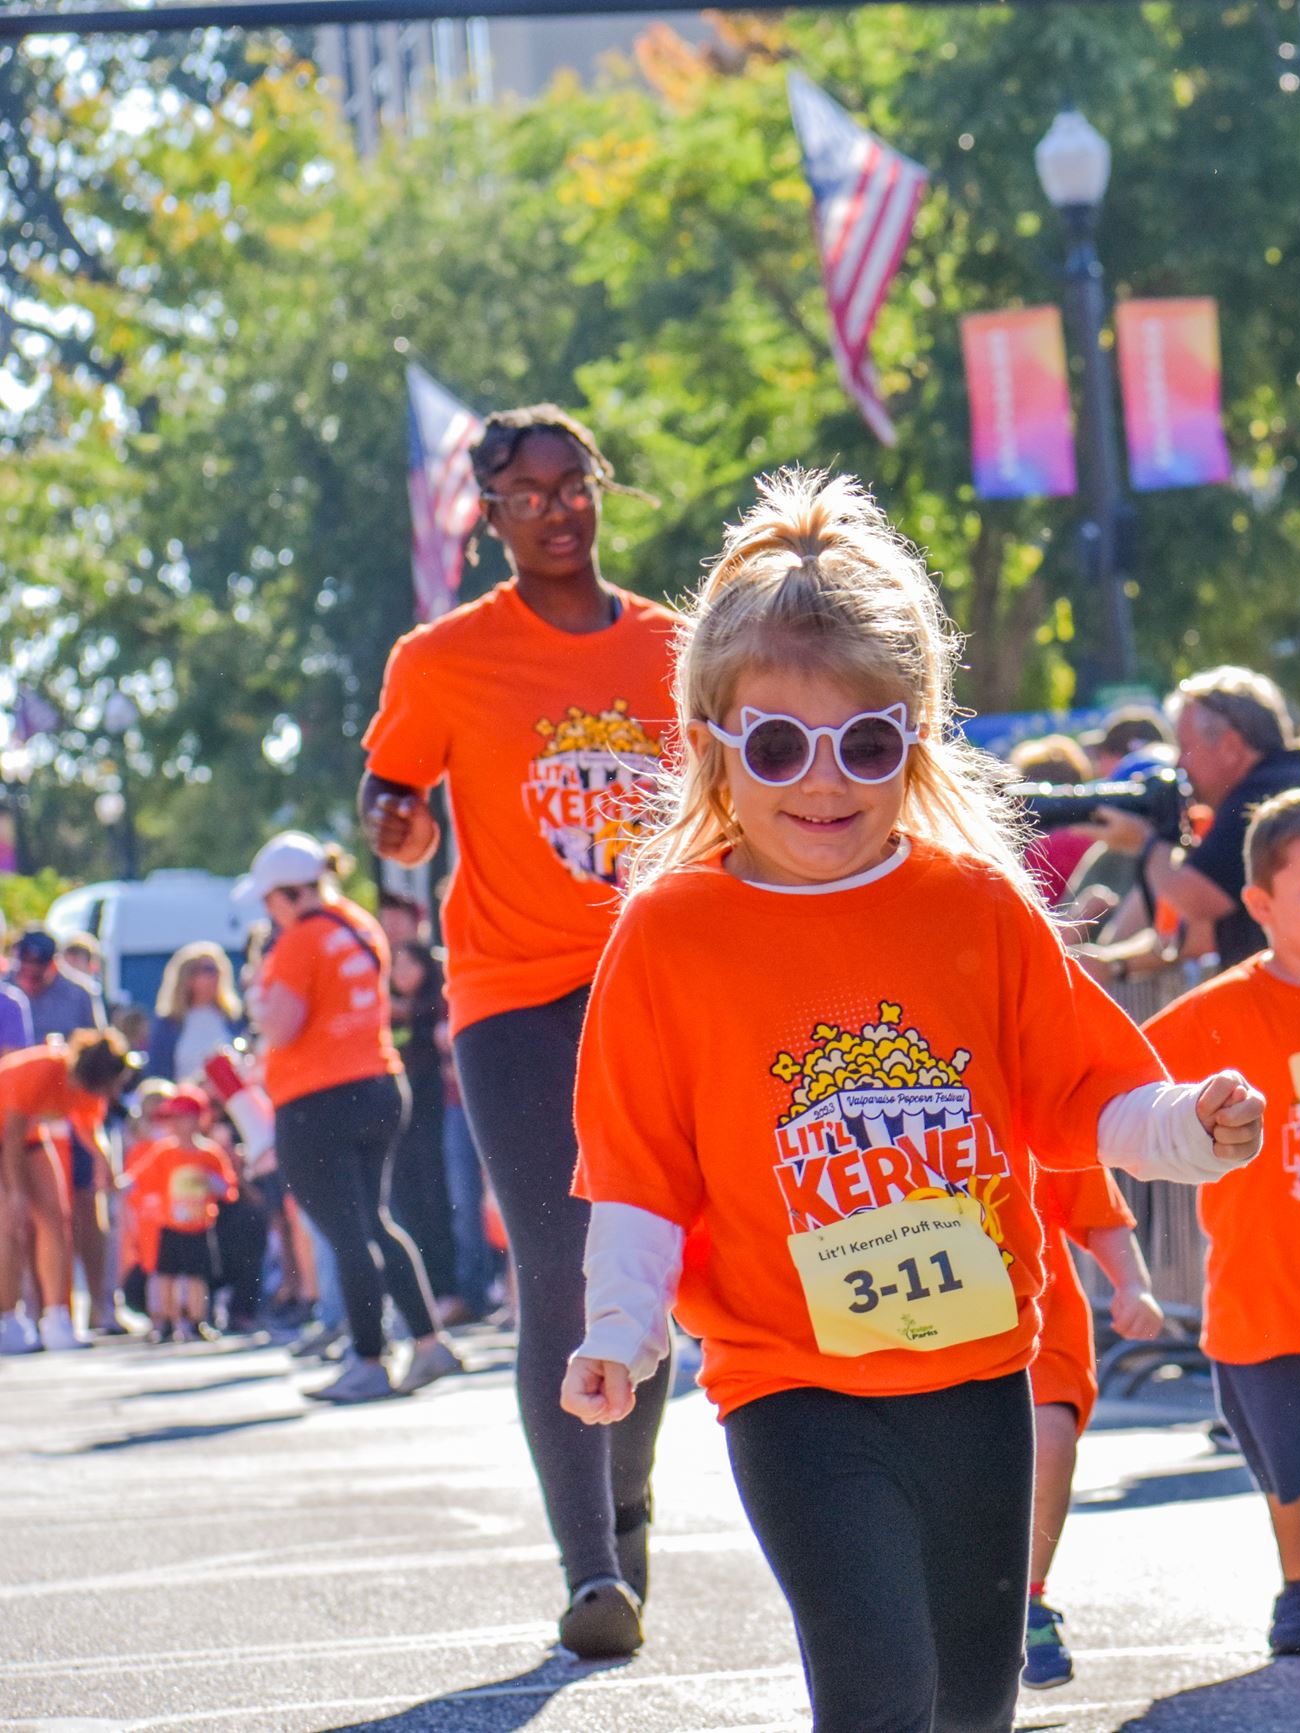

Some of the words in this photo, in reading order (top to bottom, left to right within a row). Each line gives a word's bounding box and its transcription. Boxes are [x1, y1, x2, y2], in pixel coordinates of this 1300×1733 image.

[813, 1102, 836, 1120] 2023
[846, 1092, 896, 1107] Valparaiso
[898, 1092, 933, 1106] Popcorn
[935, 1091, 966, 1103] Festival
[775, 1118, 855, 1160] LIT'L
[774, 1115, 1009, 1231] KERNEL
[849, 1228, 898, 1254] Kernel
[900, 1220, 930, 1238] Puff
[932, 1219, 962, 1231] Run
[842, 1249, 964, 1315] 3-11
